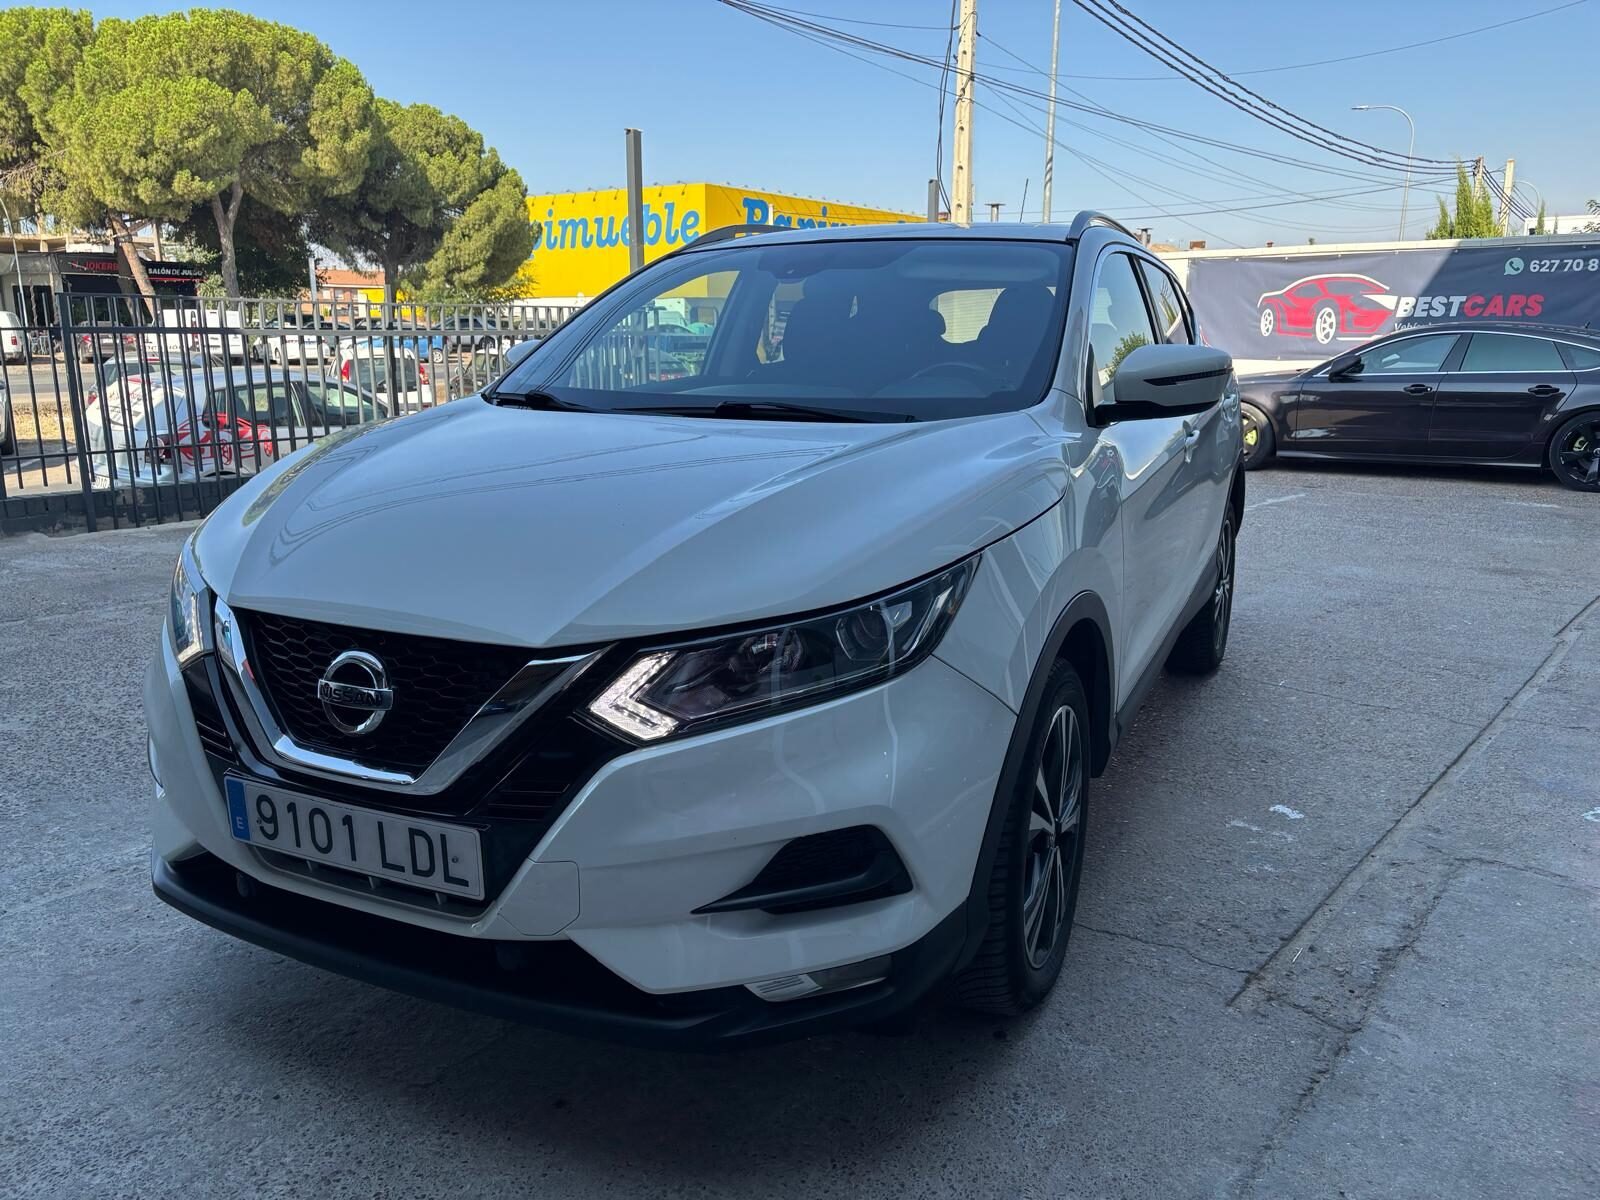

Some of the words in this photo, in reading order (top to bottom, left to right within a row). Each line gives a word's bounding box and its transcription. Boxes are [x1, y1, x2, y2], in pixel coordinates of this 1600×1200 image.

[148, 266, 171, 275] SALÓN
[172, 268, 180, 276] DE
[1529, 259, 1561, 273] 627
[1562, 258, 1584, 272] 70
[1587, 258, 1599, 272] 8
[1395, 293, 1545, 318] BESTCARS
[321, 683, 384, 705] NISSAN
[236, 816, 245, 830] E
[255, 794, 357, 862] 9101
[377, 820, 470, 888] LDL
